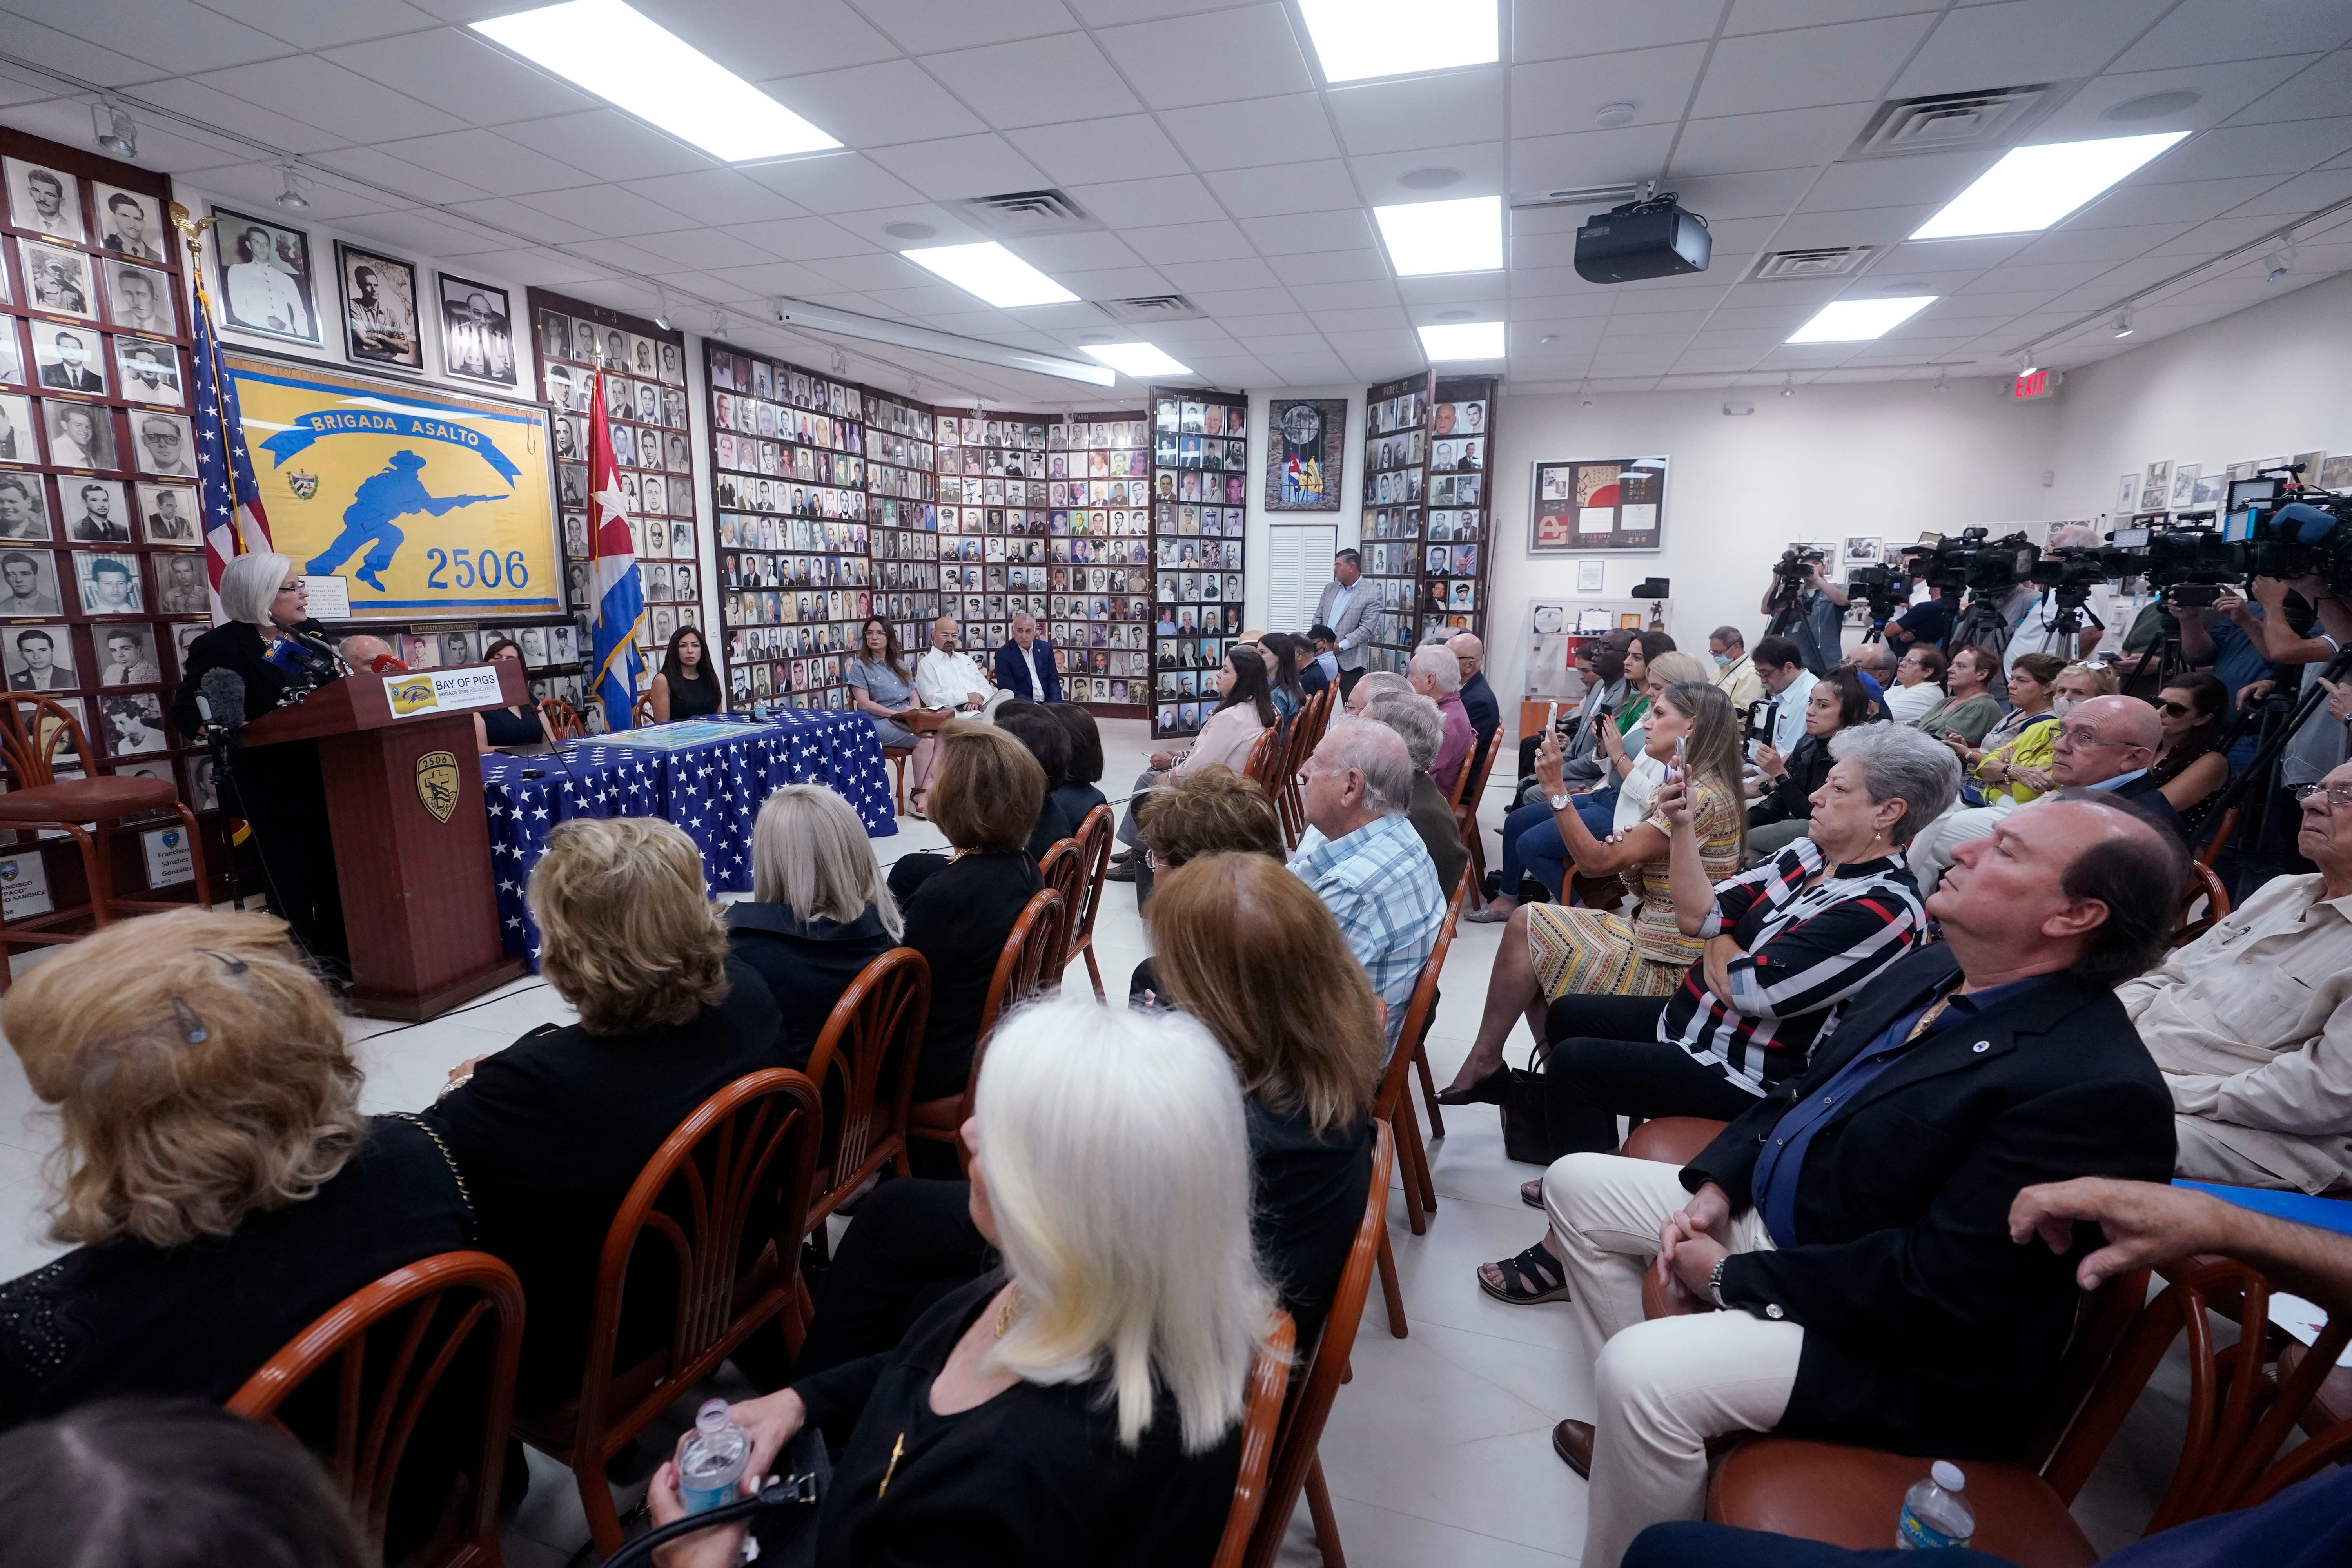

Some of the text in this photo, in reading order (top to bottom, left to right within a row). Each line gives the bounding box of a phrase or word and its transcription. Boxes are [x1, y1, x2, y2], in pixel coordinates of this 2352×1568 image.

[2015, 372, 2047, 397] EXIT
[311, 415, 478, 446] BRIGADA ASALTO
[427, 548, 528, 589] 2506
[273, 639, 282, 649] 4
[436, 675, 495, 690] BAY OF PIGS
[423, 756, 447, 768] 2506
[158, 848, 189, 858] Francisco
[162, 858, 189, 867] Sánchez
[162, 866, 192, 876] González
[1, 881, 32, 890] ANCISCO
[13, 890, 46, 901] SANCHEZ
